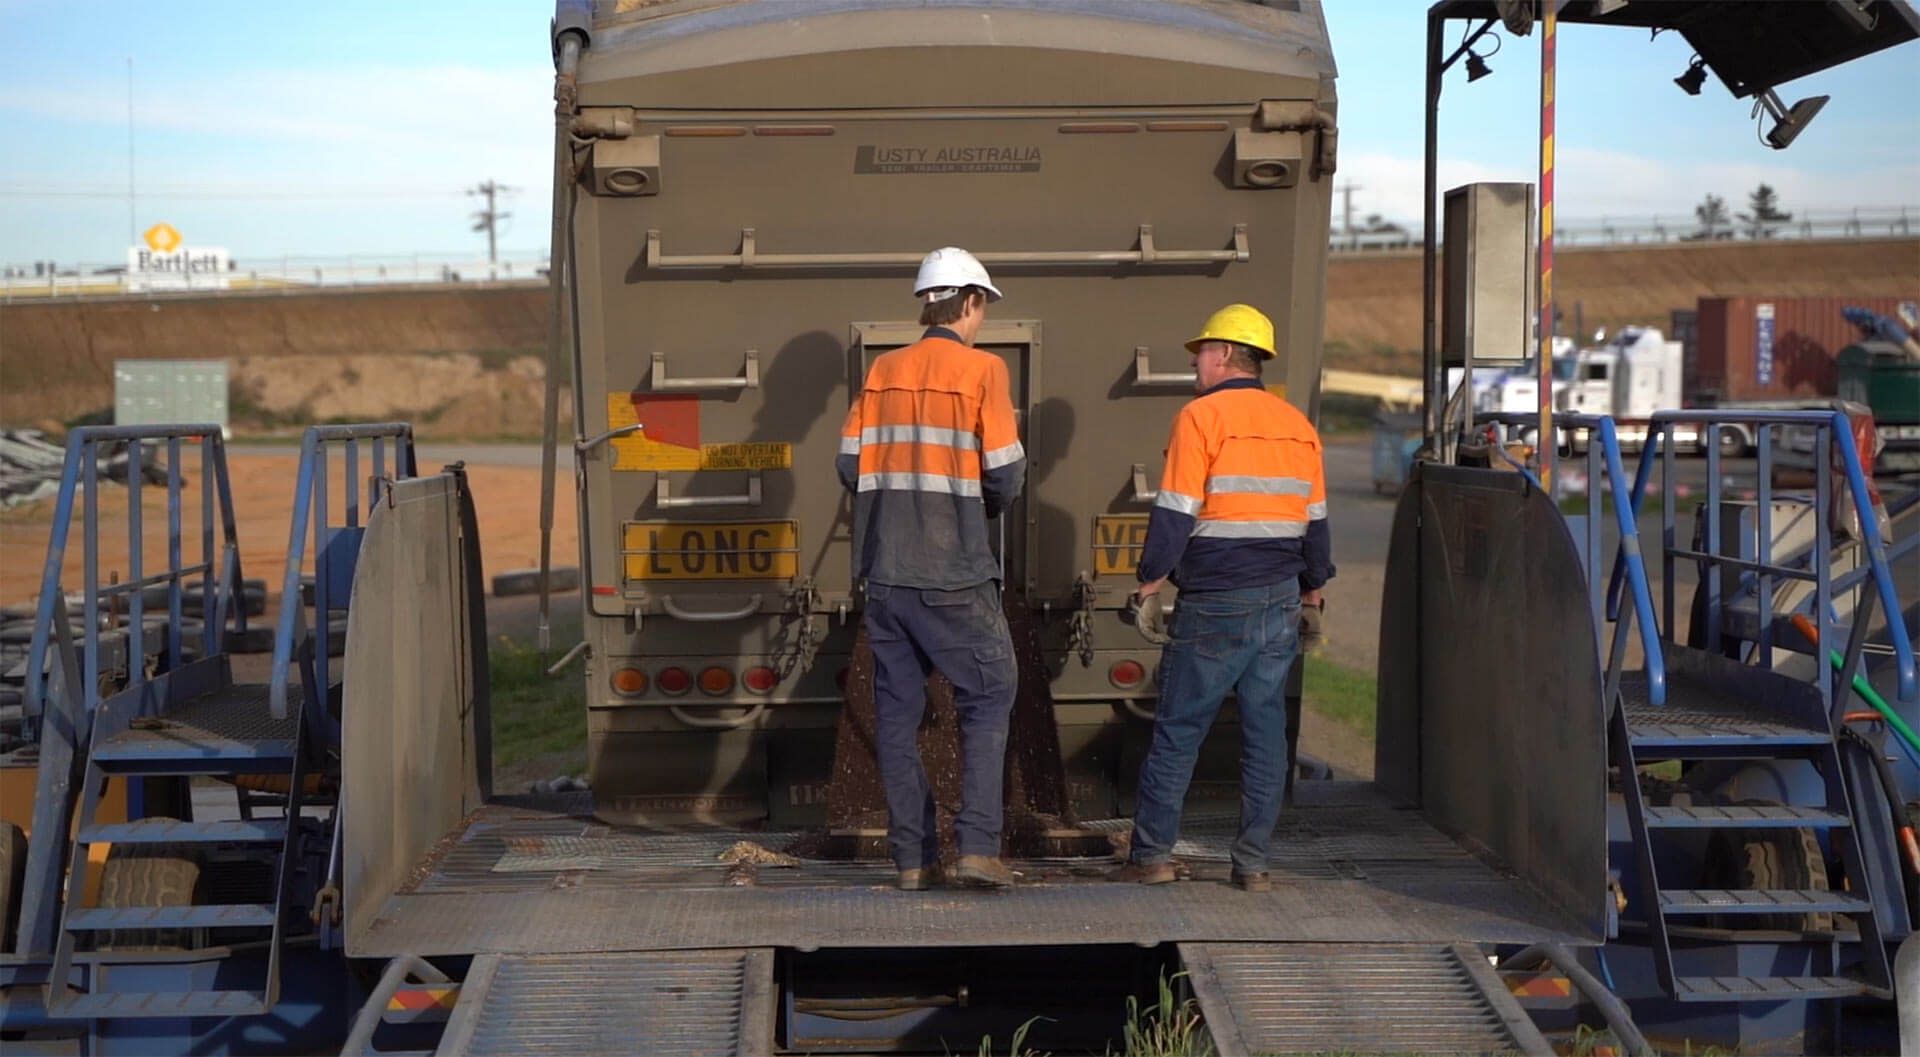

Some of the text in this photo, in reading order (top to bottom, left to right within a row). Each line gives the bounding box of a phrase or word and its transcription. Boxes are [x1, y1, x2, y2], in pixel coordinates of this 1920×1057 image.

[935, 147, 1041, 162] AUSTRALIA
[138, 251, 217, 274] Bartlett
[720, 445, 737, 456] NOT
[649, 529, 773, 574] LONG
